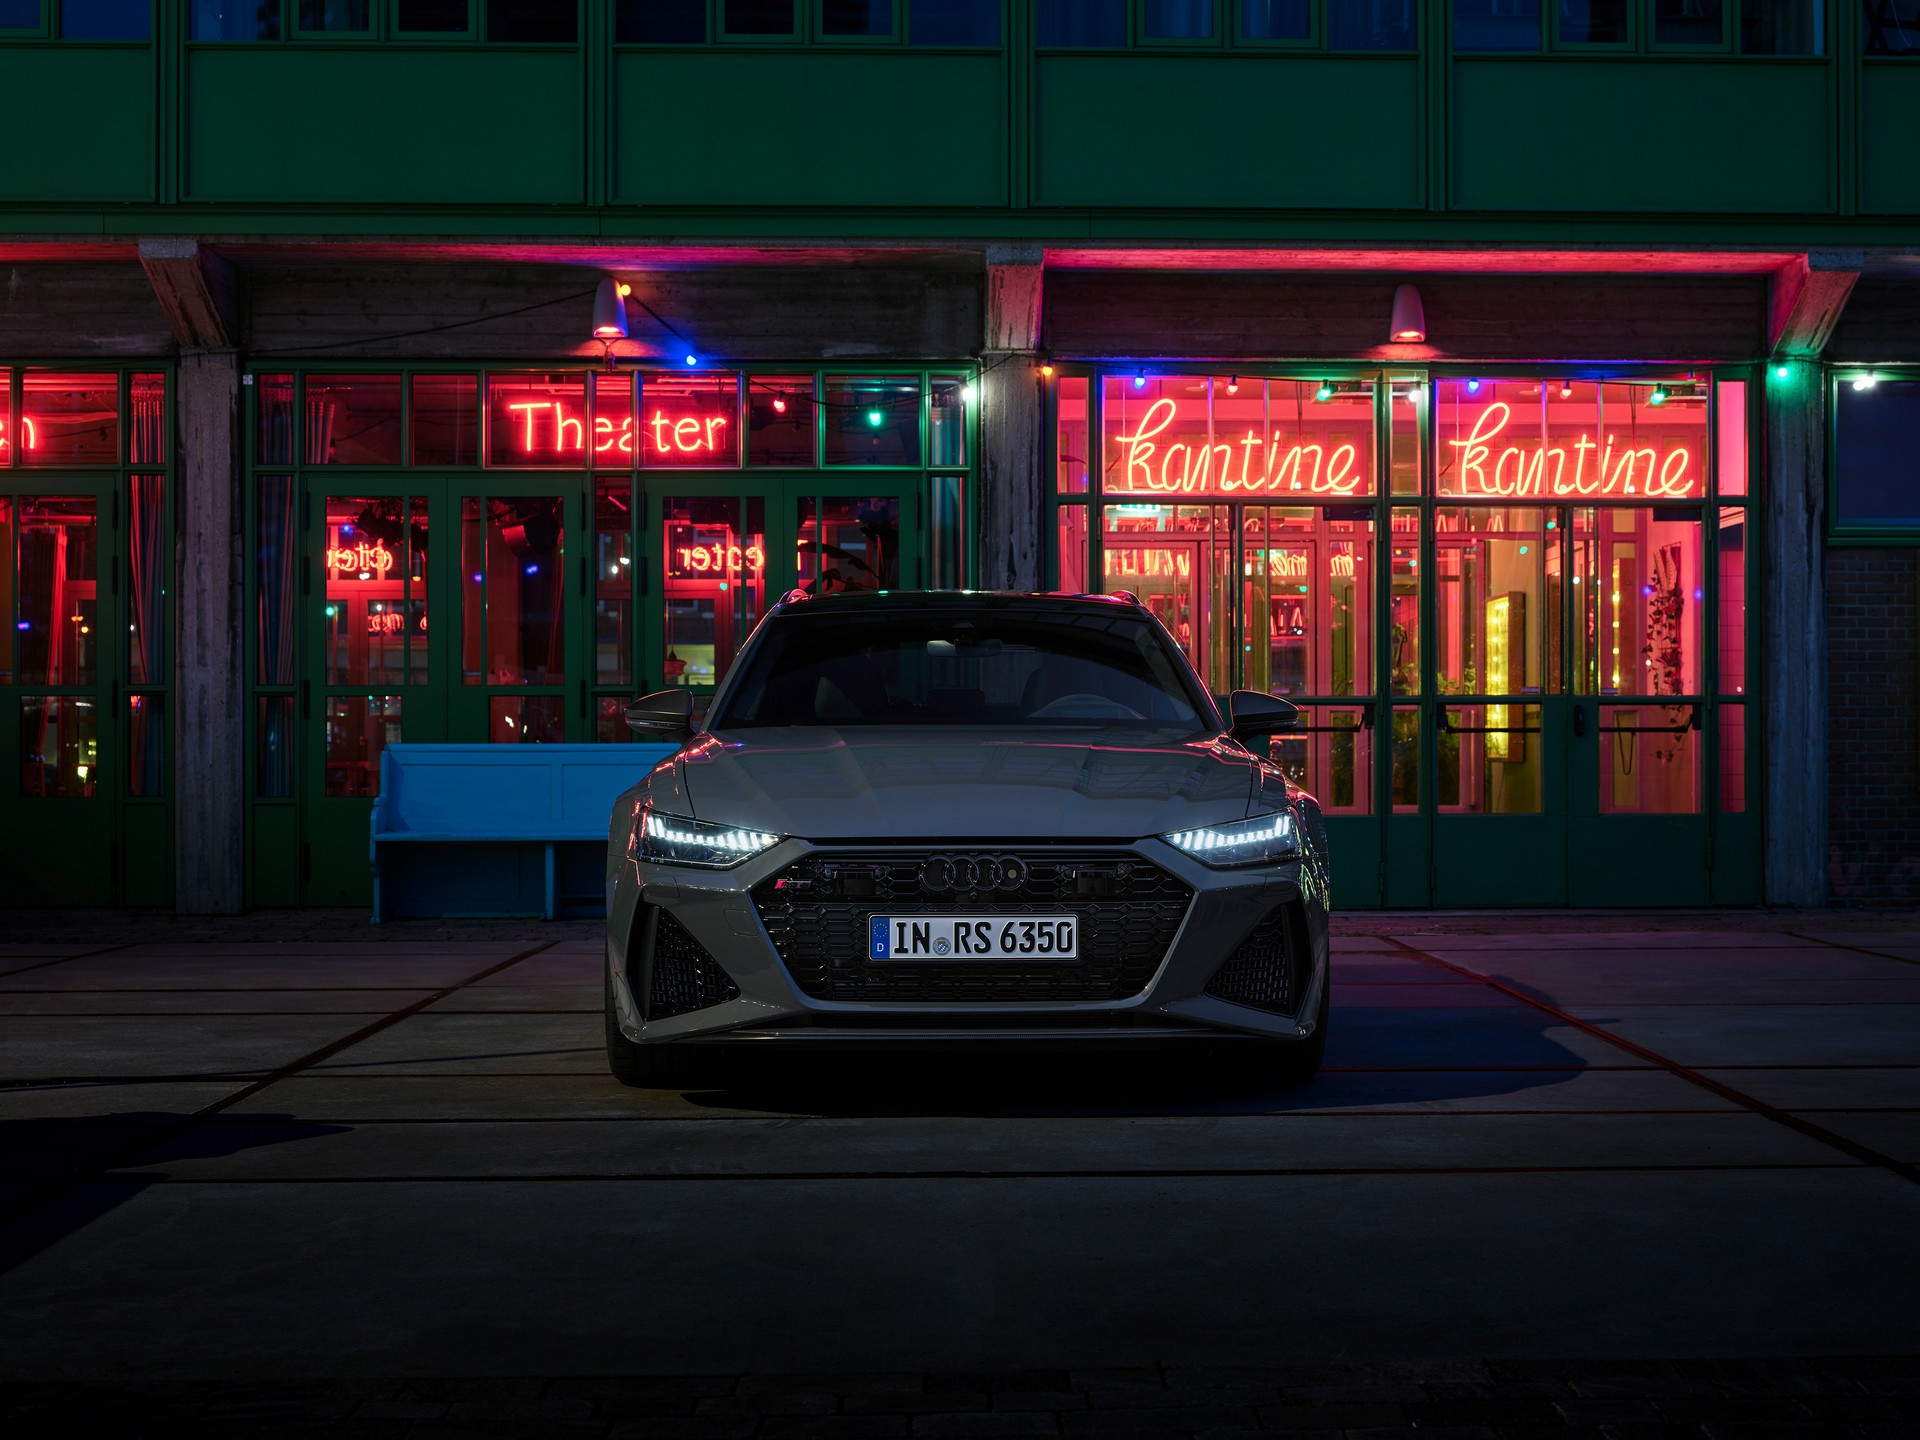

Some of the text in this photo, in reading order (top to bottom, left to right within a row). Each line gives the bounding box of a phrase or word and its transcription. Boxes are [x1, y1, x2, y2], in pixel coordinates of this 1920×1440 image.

[509, 400, 727, 452] Theater
[1116, 398, 1361, 493] kantine
[1449, 402, 1694, 497] kantine
[876, 921, 1073, 954] D IN RS 6350
